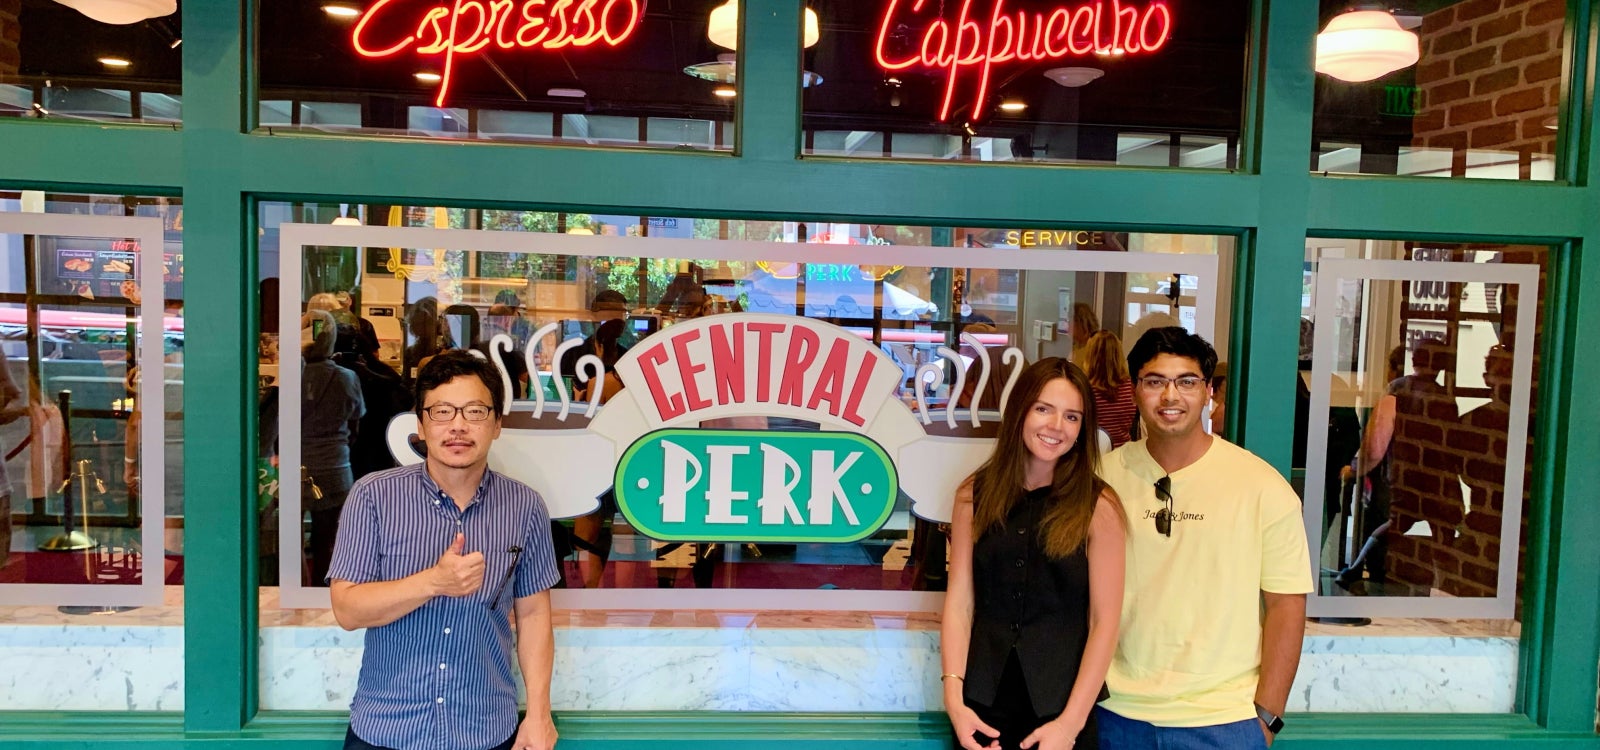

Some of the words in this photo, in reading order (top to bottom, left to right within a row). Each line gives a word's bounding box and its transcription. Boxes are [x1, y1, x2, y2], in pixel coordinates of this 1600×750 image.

[876, 0, 1170, 121] Cappuccino
[1007, 231, 1104, 246] SERVICE
[806, 264, 853, 282] PERK
[637, 322, 878, 427] CENTRAL
[659, 439, 864, 526] PERK
[1143, 509, 1169, 521] Jak
[1178, 511, 1205, 522] Jones
